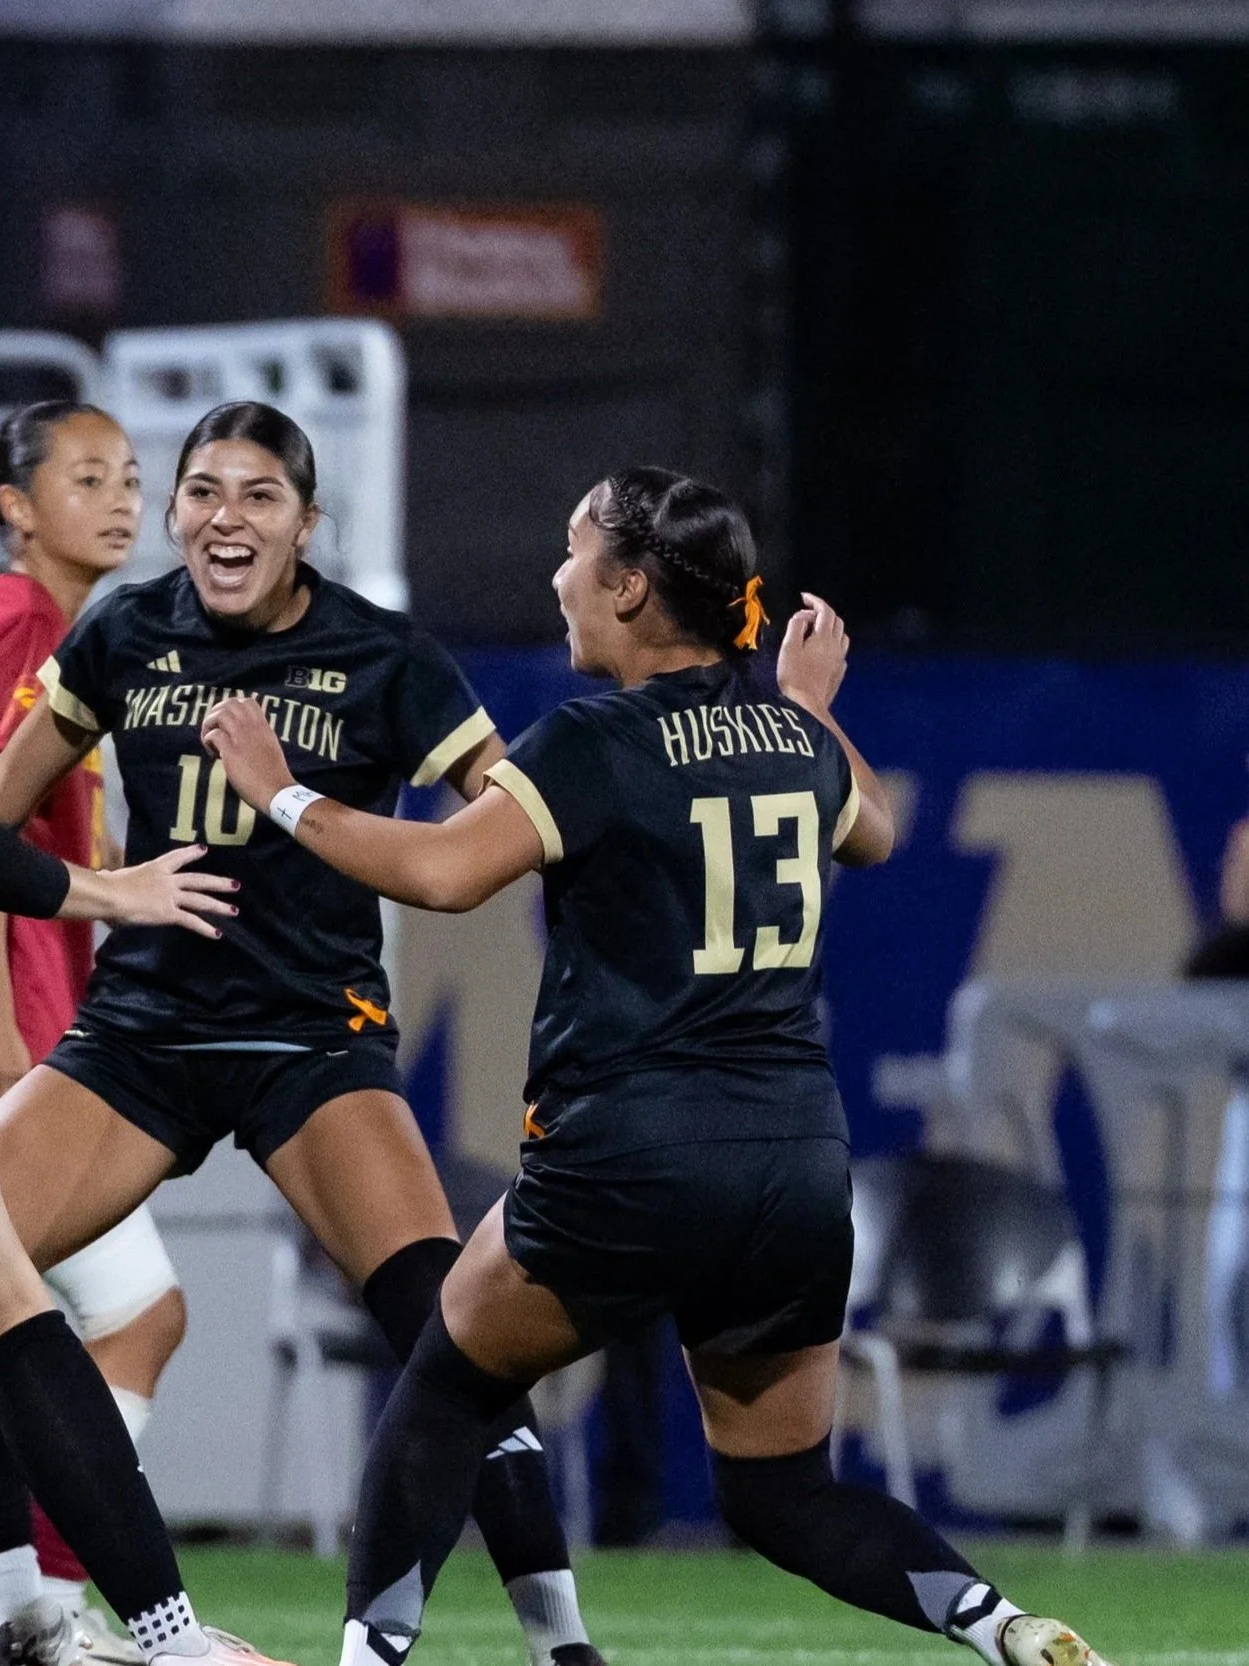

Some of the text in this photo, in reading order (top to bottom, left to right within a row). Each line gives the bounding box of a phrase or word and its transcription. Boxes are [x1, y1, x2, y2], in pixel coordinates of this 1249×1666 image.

[124, 684, 345, 763] WASHGTON
[658, 703, 815, 767] HUSKIES
[690, 791, 821, 974] 13
